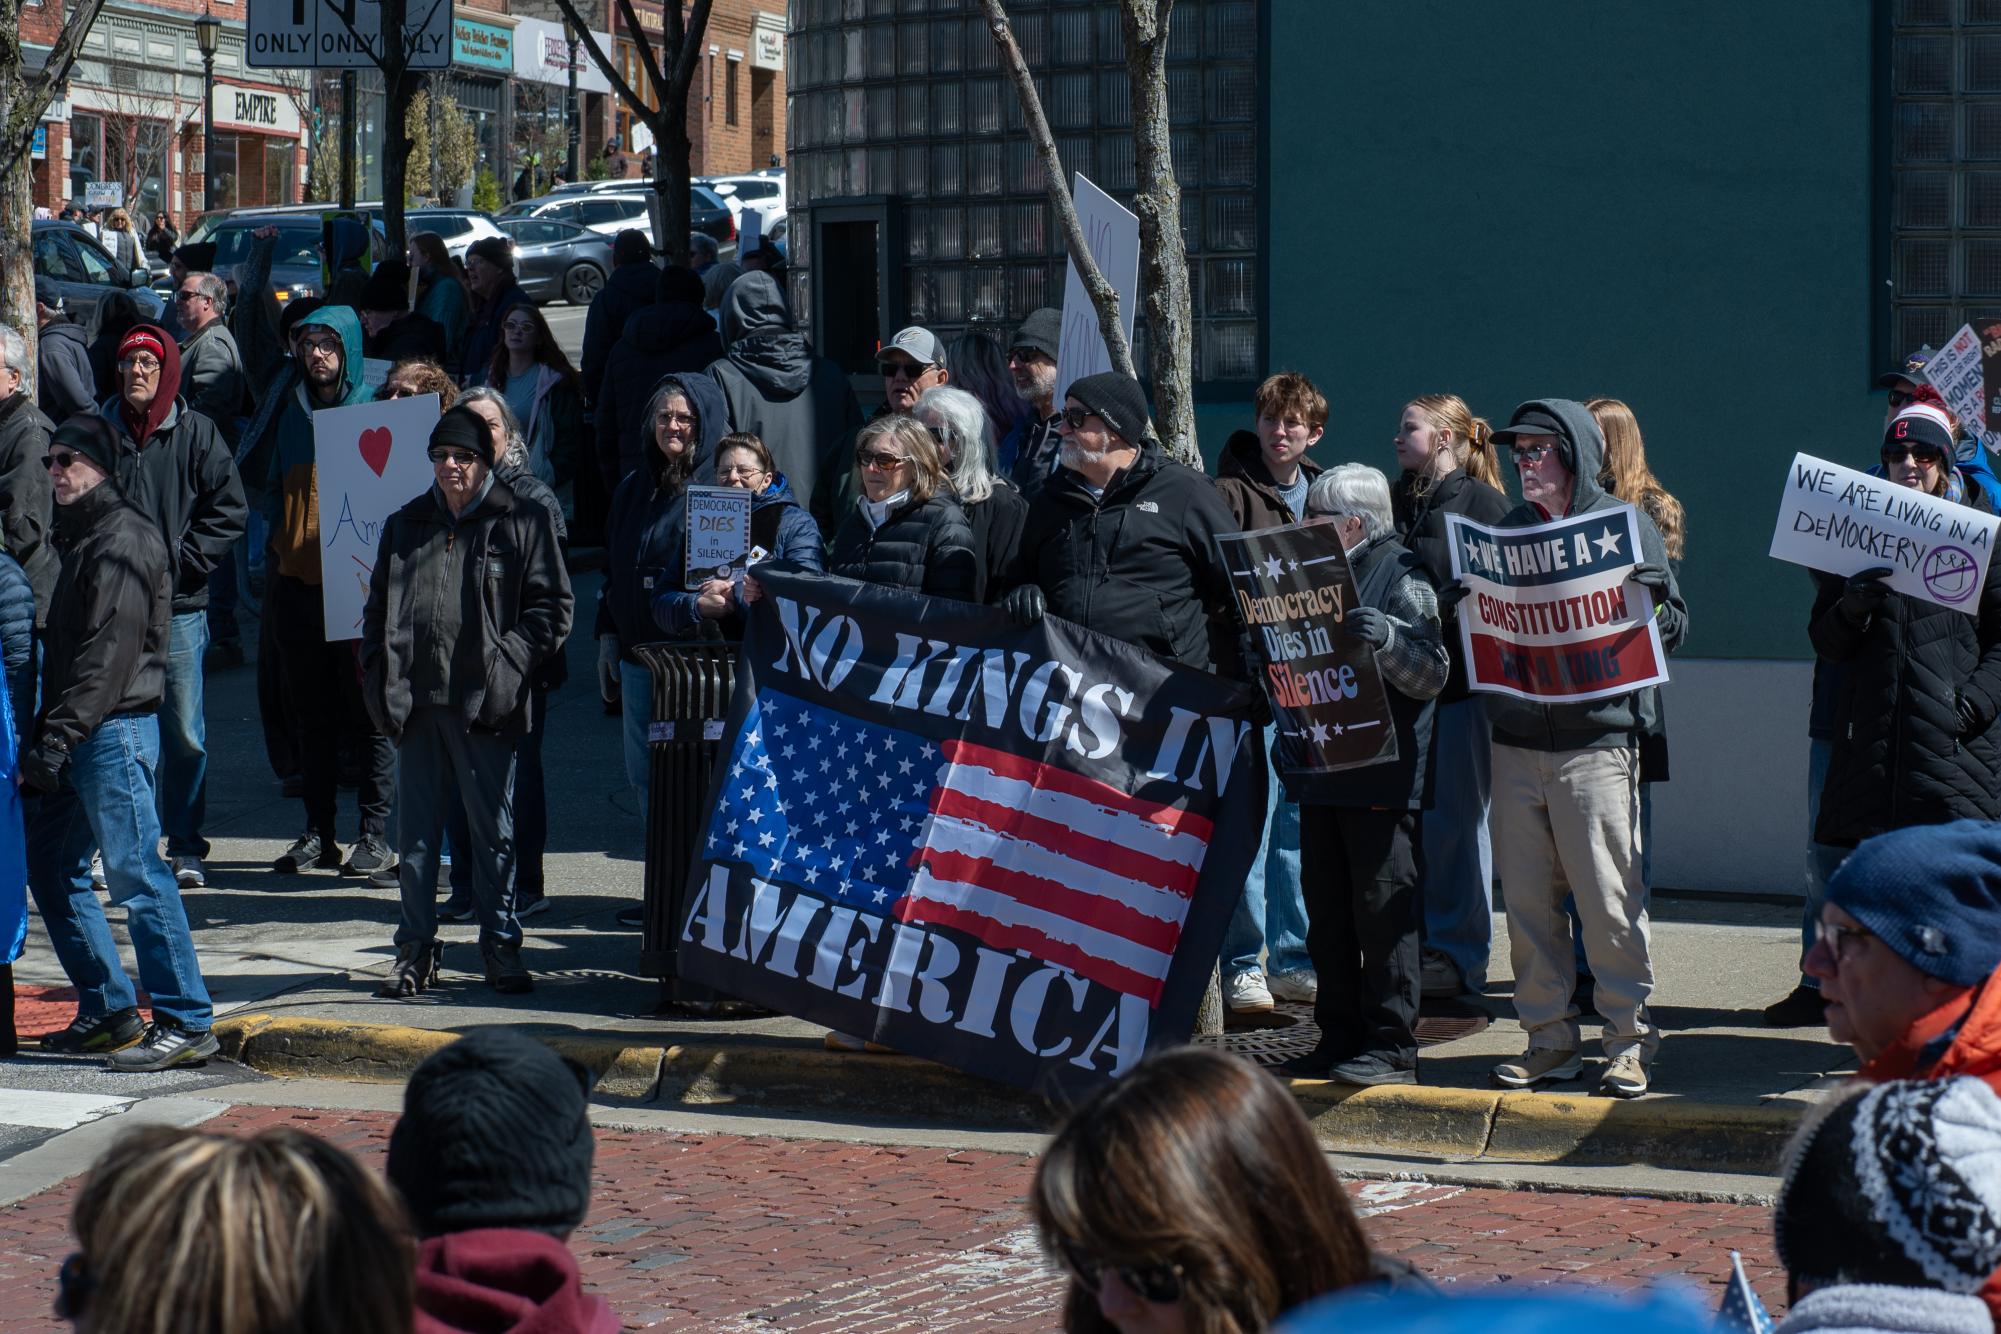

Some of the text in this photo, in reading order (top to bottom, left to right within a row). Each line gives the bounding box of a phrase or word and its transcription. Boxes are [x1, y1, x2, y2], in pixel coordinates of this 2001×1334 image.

[254, 33, 312, 53] ONLY
[321, 33, 377, 53] ONLY
[402, 34, 444, 54] NLY
[235, 91, 277, 125] EMPIRE
[1953, 331, 1973, 356] NOT
[1944, 361, 1984, 409] MOMEN
[1895, 421, 1908, 438] C
[693, 500, 743, 513] DEMOCRACY
[699, 515, 736, 532] DIES
[1797, 464, 1988, 550] WE ARE LIVING IN A
[697, 548, 735, 560] SILENCE
[710, 536, 719, 546] in
[1478, 532, 1593, 576] WE HAVE A
[1239, 584, 1344, 624] Democracy
[1478, 585, 1628, 635] CONSTITUTION
[1262, 620, 1335, 662] Dies in
[772, 596, 1252, 798] NO KINGS IN
[1268, 664, 1358, 708] Silence
[682, 863, 1151, 1079] AMERICA
